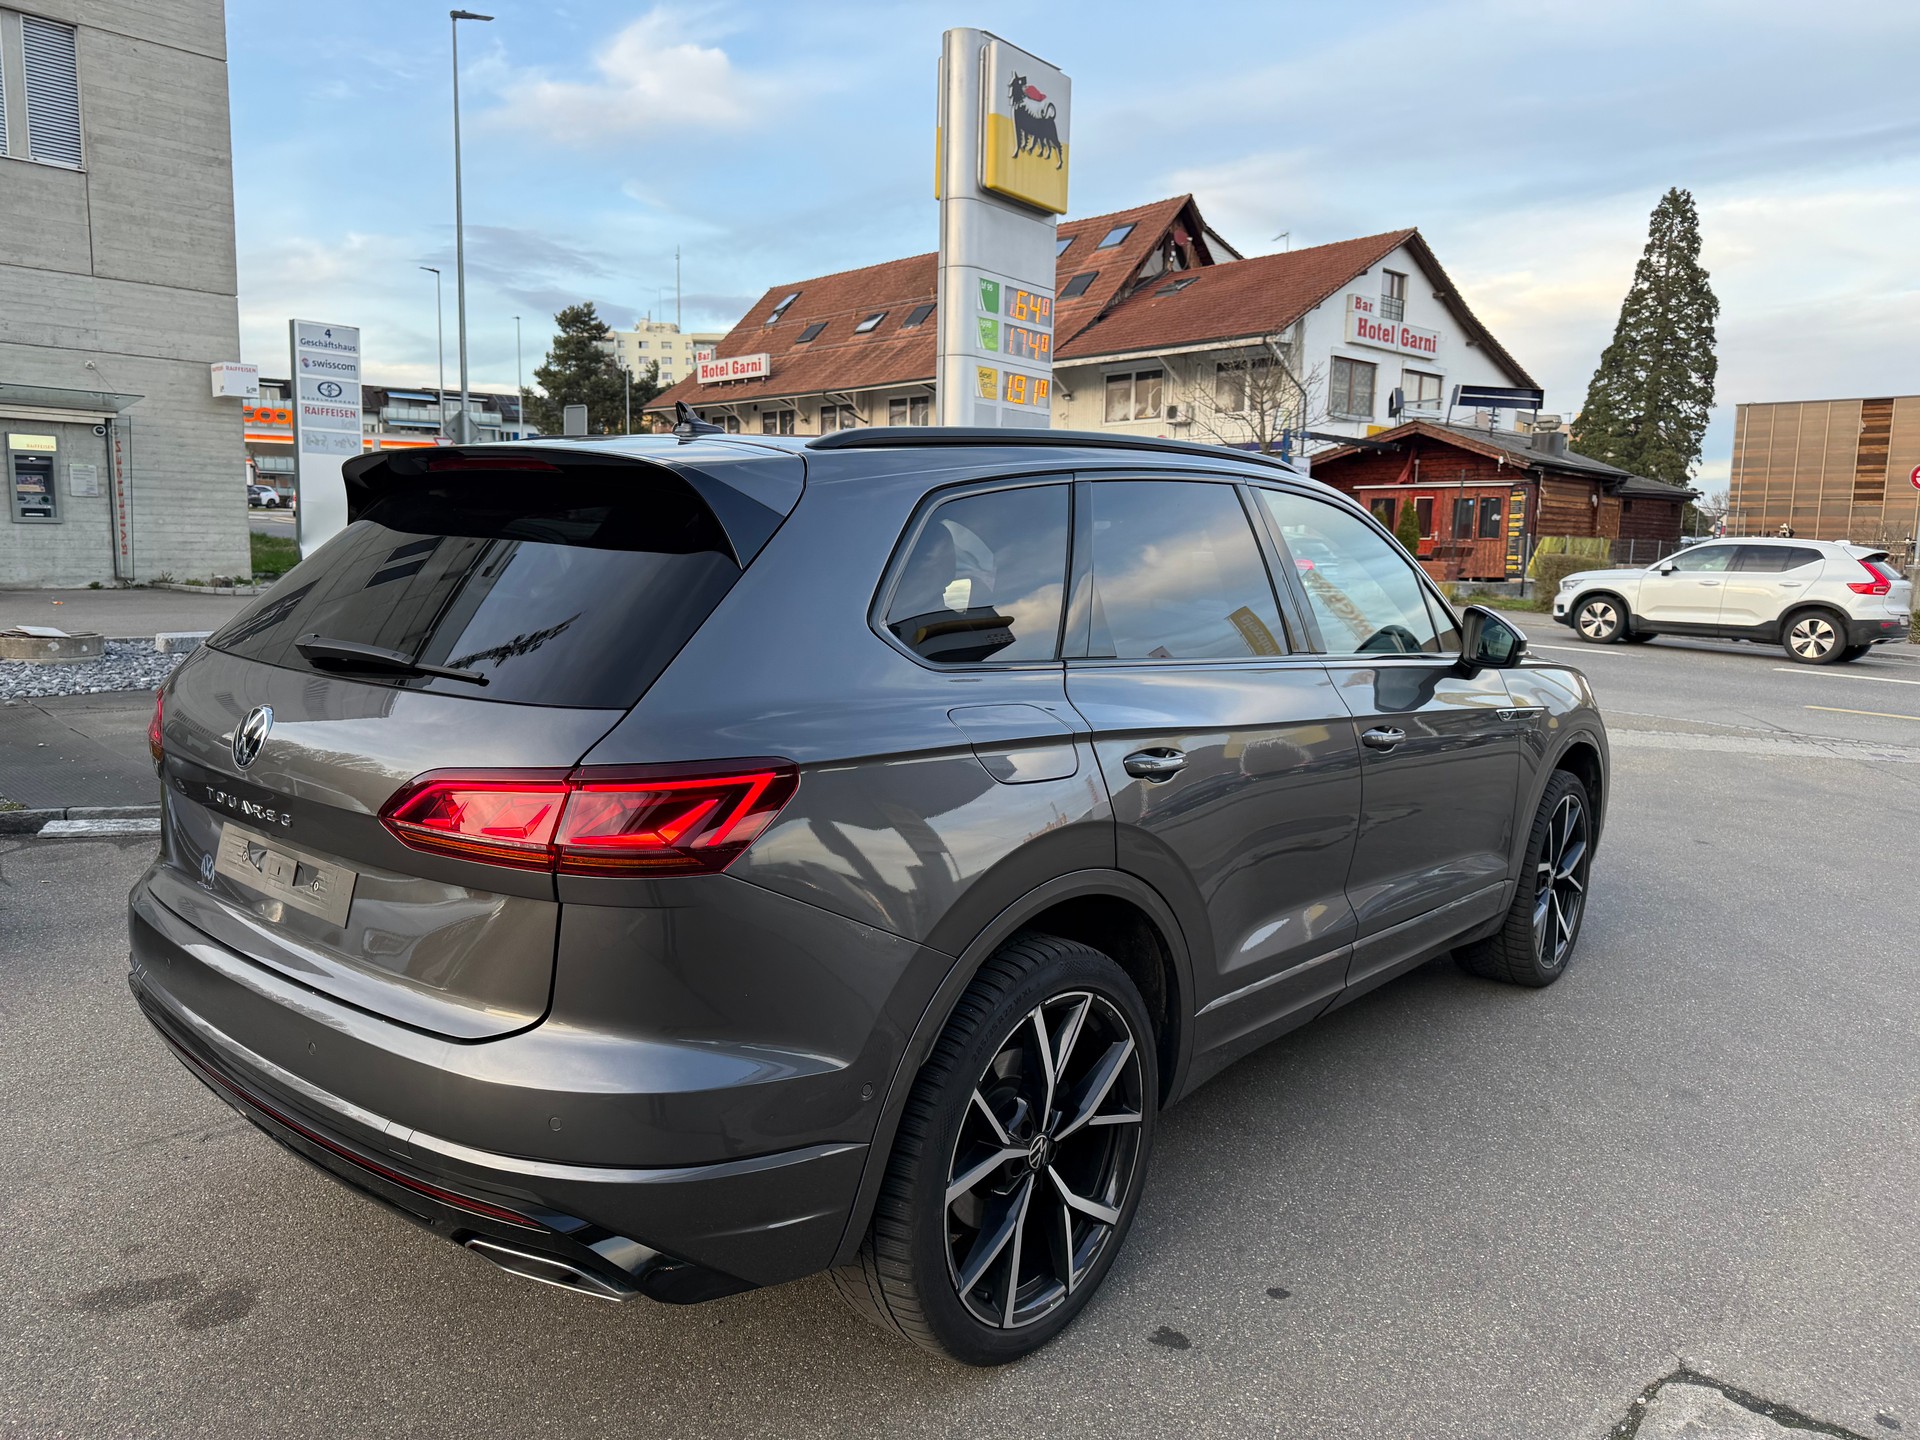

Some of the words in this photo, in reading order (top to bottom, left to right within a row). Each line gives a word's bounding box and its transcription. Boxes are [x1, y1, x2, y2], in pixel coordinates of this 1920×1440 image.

[1354, 296, 1373, 313] Bar
[324, 329, 332, 338] 4
[1357, 317, 1395, 344] Hotel
[1401, 327, 1437, 353] Garni
[300, 337, 357, 351] Geschäftshaus
[697, 352, 710, 361] Bar
[225, 365, 257, 373] RAIFFEISEN
[312, 359, 356, 371] swisscom
[701, 362, 729, 379] Hotel
[732, 358, 762, 375] Garni
[304, 406, 356, 419] RAIFFEISEN
[206, 784, 292, 827] TOUAREG
